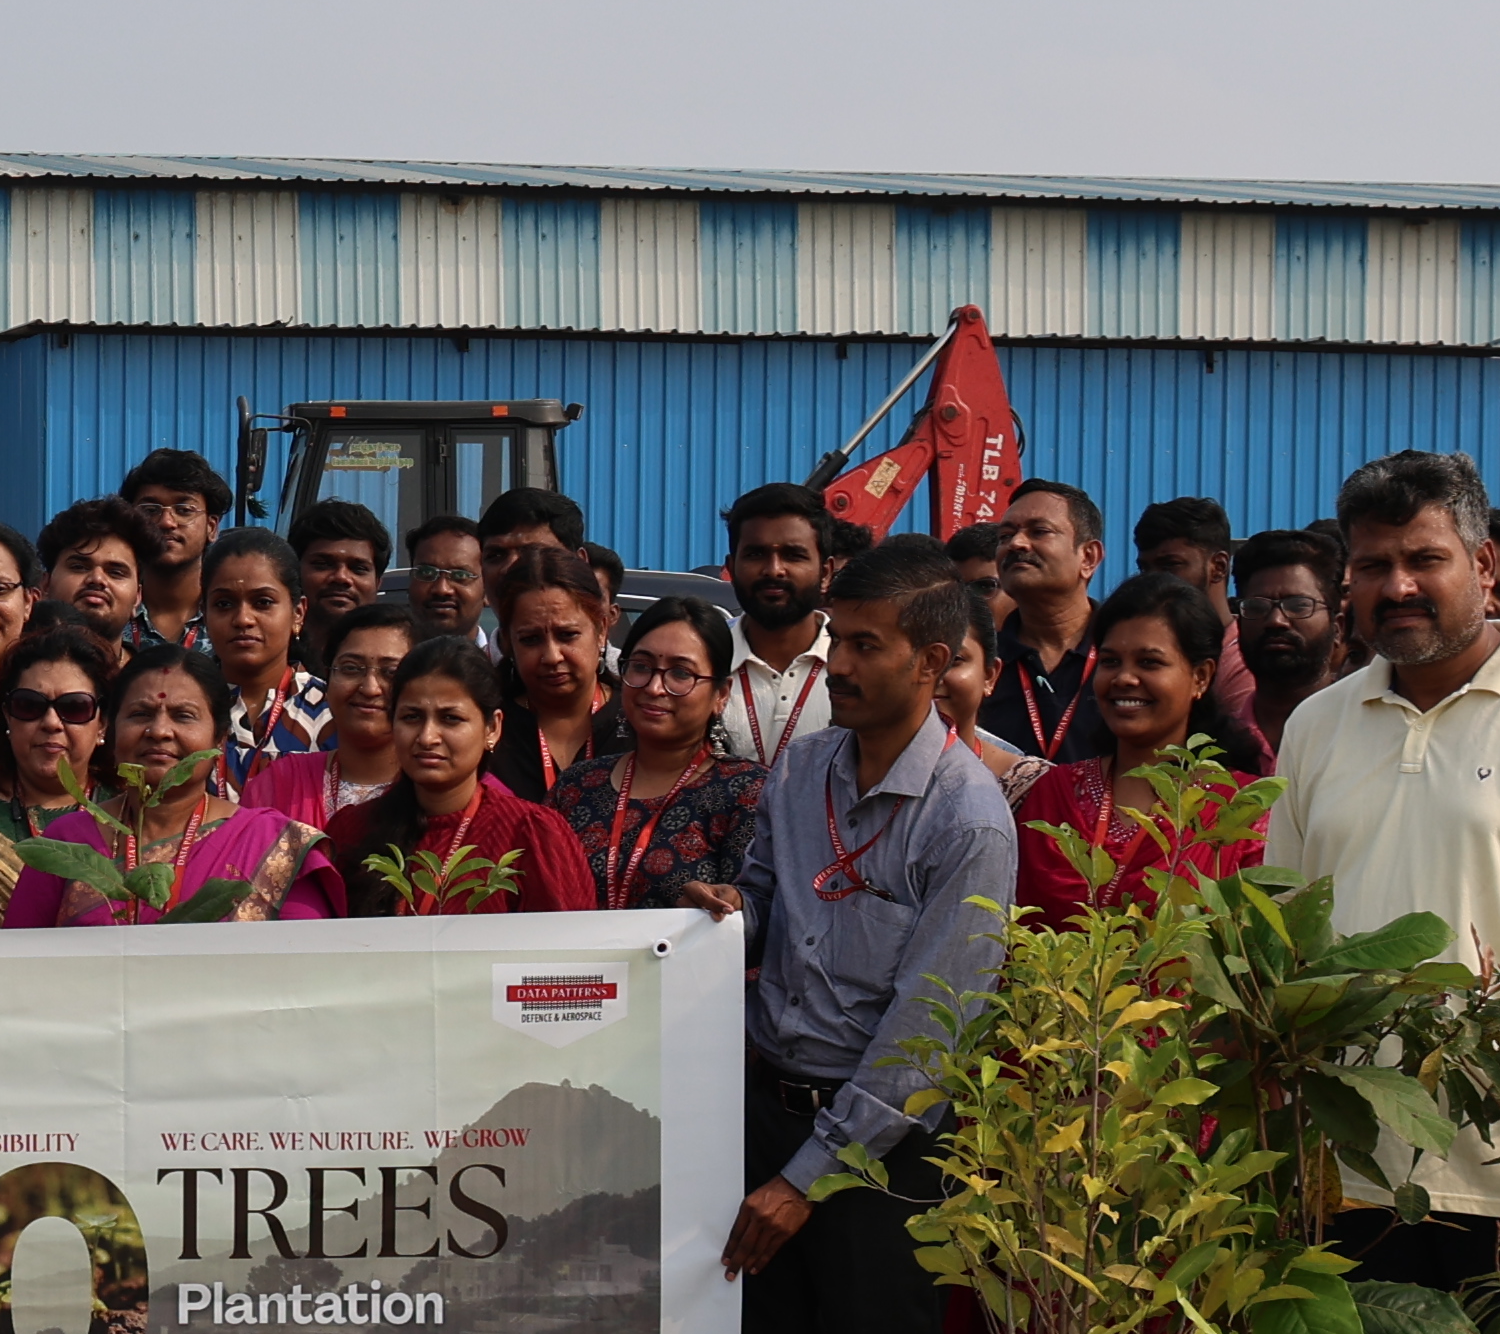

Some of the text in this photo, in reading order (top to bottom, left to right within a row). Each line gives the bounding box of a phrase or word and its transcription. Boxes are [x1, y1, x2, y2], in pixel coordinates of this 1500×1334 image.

[975, 434, 1004, 523] TLB 74
[616, 791, 627, 811] DATA
[176, 813, 201, 866] DATA PATTERNS
[450, 817, 472, 856] PATTERNS
[606, 846, 617, 886] PATTERNS
[622, 847, 644, 886] PATTERNS
[1102, 864, 1126, 905] PATTERNS
[517, 986, 609, 999] DATA PATTERNS
[521, 1011, 602, 1023] DEFENCE & AEROSPACE
[160, 1127, 531, 1152] WE CARE. WE NURTURE. WE GROW
[156, 1163, 508, 1260] TREES
[178, 1280, 444, 1325] Plantation
